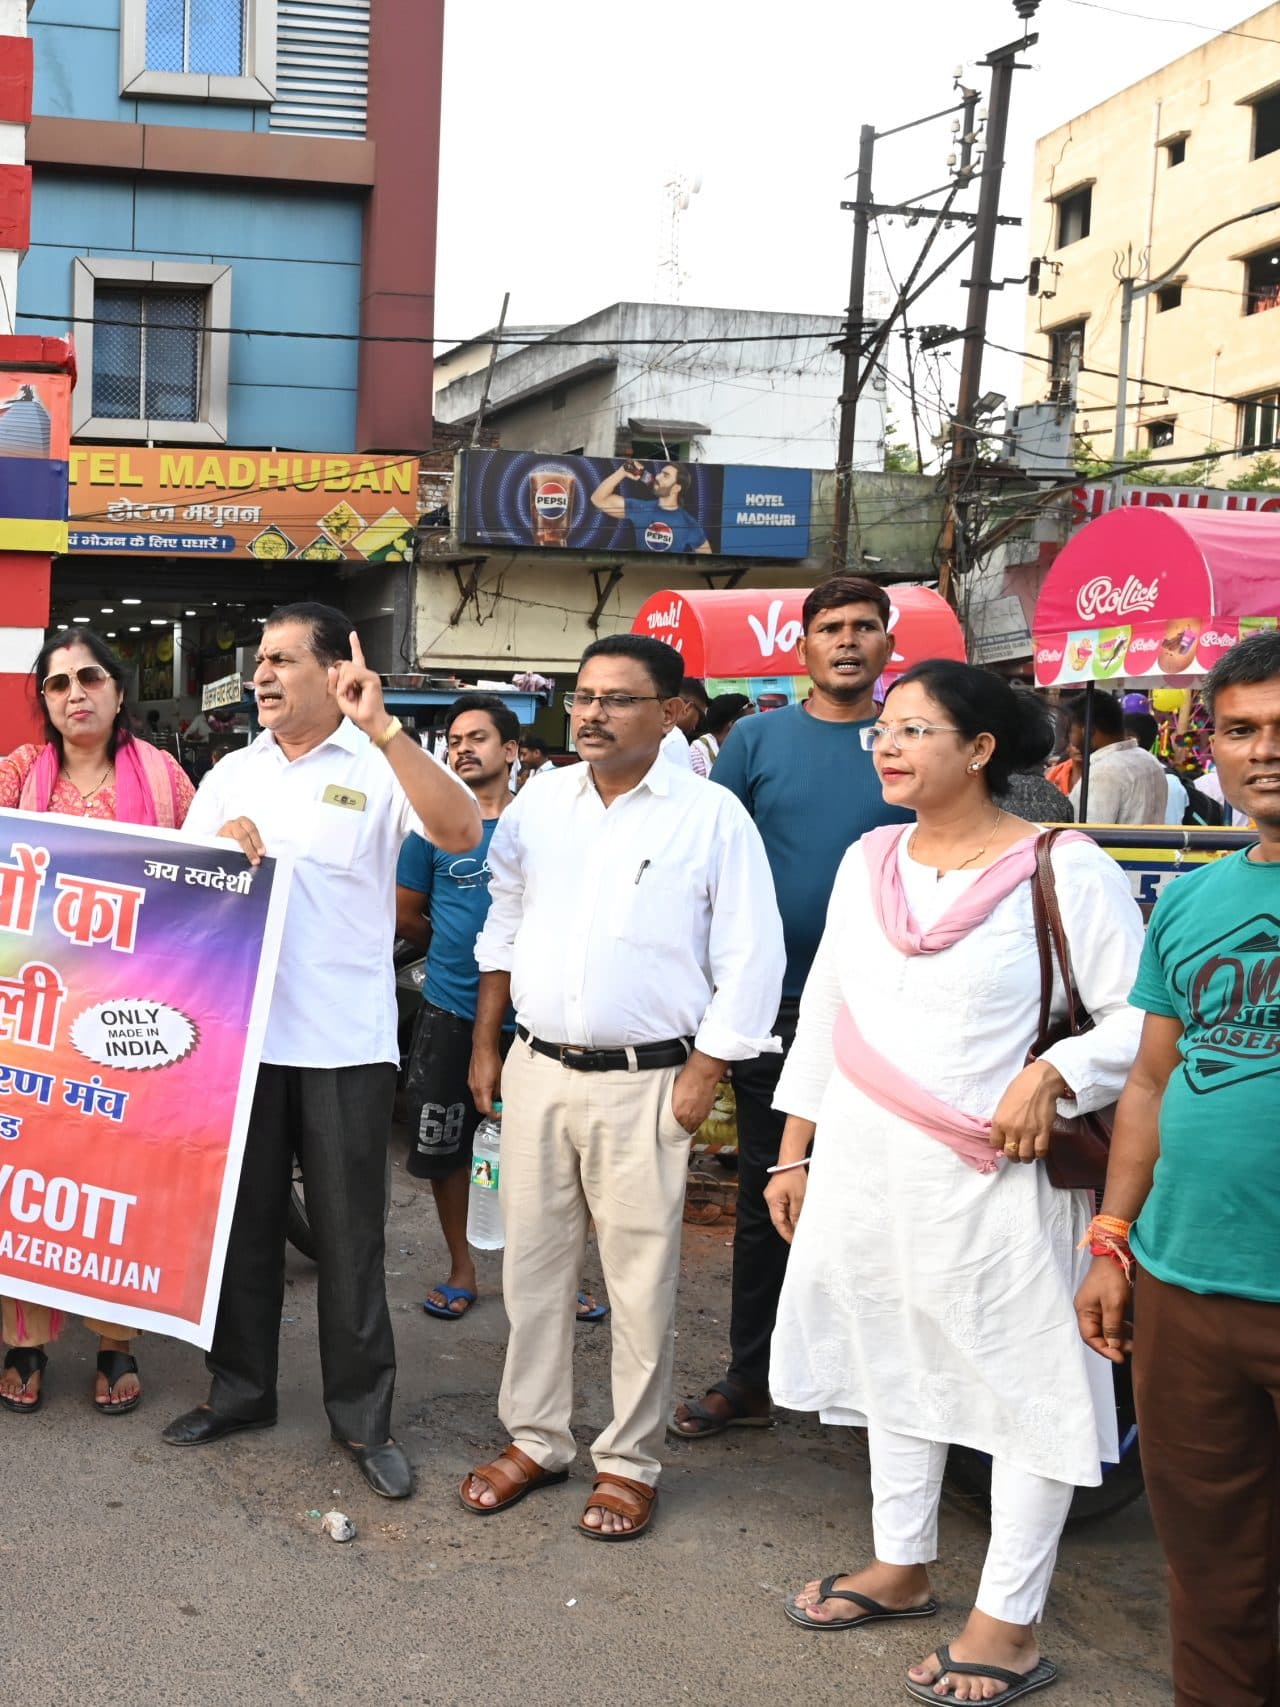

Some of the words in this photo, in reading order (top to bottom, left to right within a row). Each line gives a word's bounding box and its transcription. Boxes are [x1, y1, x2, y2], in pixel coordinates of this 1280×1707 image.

[160, 455, 412, 493] MADHUBAN
[107, 497, 177, 522] होटल
[537, 496, 568, 507] PEPSI
[745, 493, 785, 508] HOTEL
[736, 512, 796, 527] MADHURI
[81, 533, 126, 547] भोजन
[130, 534, 146, 547] के
[149, 535, 178, 549] लिए
[646, 531, 673, 544] PEPSI
[1077, 575, 1159, 621] Rollick
[143, 859, 179, 884] जय
[184, 865, 253, 896] स्वदेशी
[54, 872, 145, 954] का
[100, 1007, 163, 1027] ONLY
[108, 1027, 145, 1040] MADE
[147, 1026, 160, 1038] IN
[105, 1039, 169, 1059] INDIA
[63, 1075, 130, 1123] मंच
[420, 1103, 465, 1144] 68
